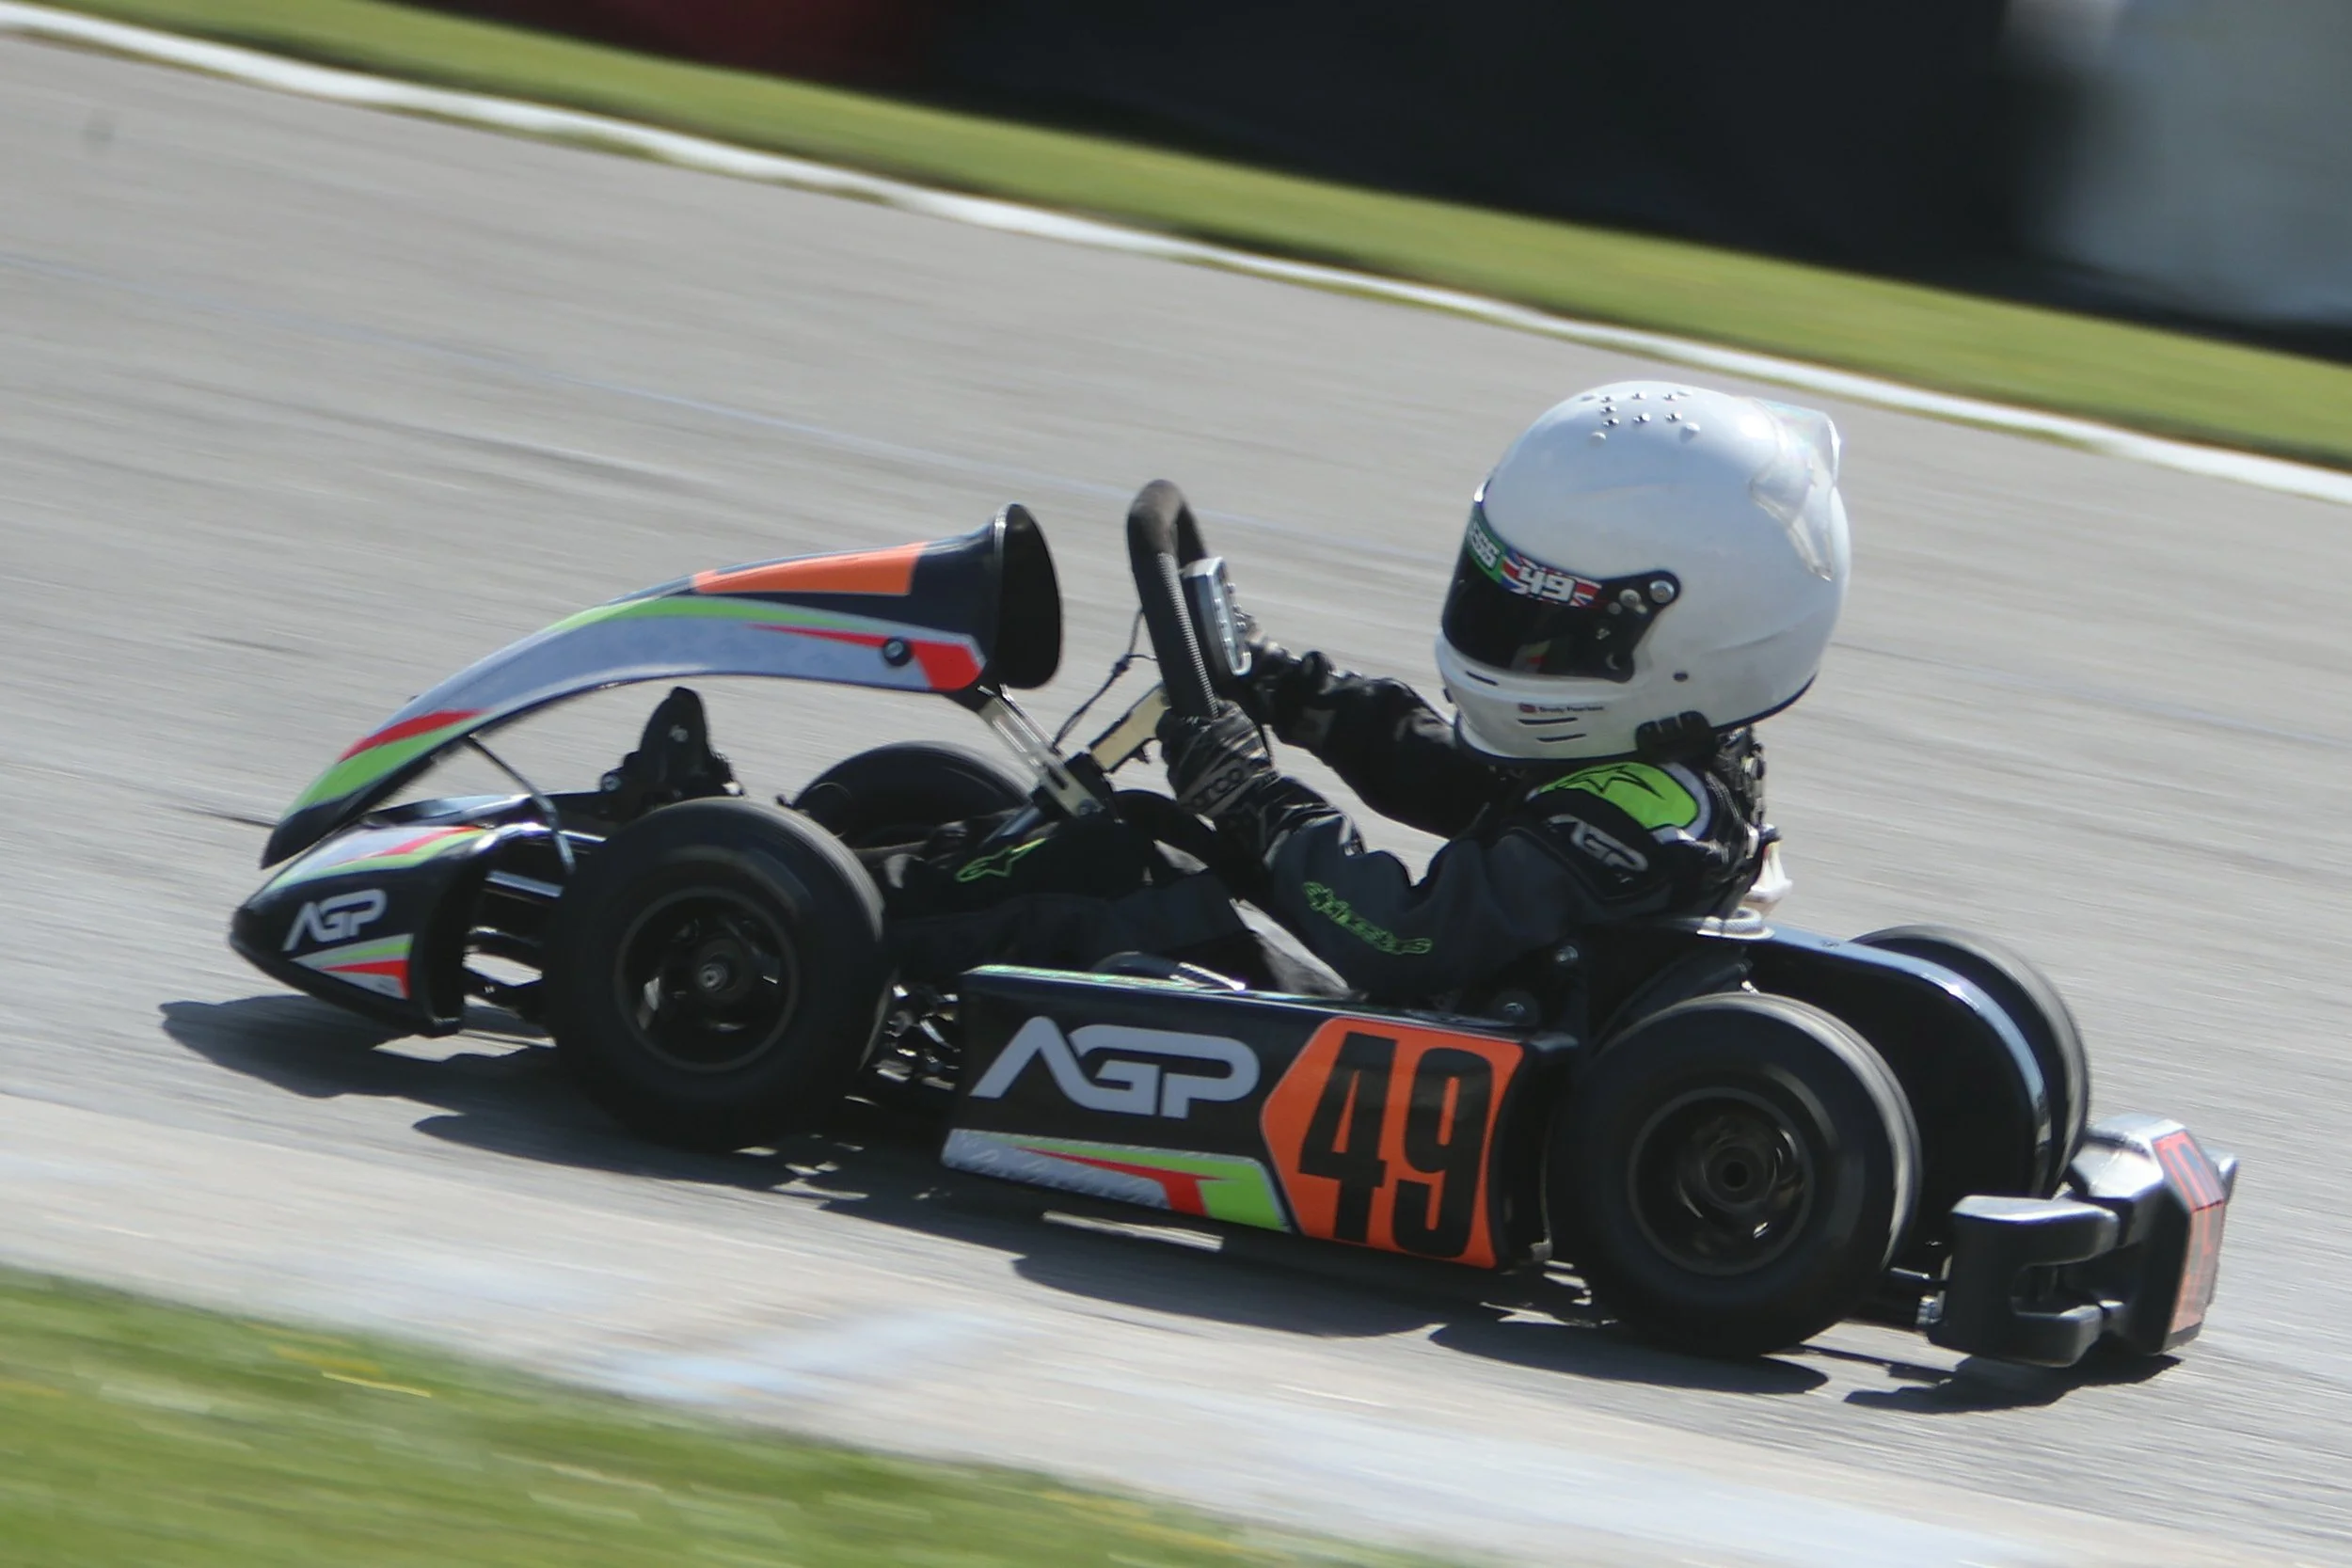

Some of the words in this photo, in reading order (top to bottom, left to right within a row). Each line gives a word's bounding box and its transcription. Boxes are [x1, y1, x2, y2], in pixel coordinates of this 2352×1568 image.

[1518, 566, 1575, 602] 49
[1547, 814, 1648, 872] AGP
[281, 888, 387, 952] AGP
[968, 1016, 1261, 1119] AGP
[1296, 1031, 1493, 1259] 49
